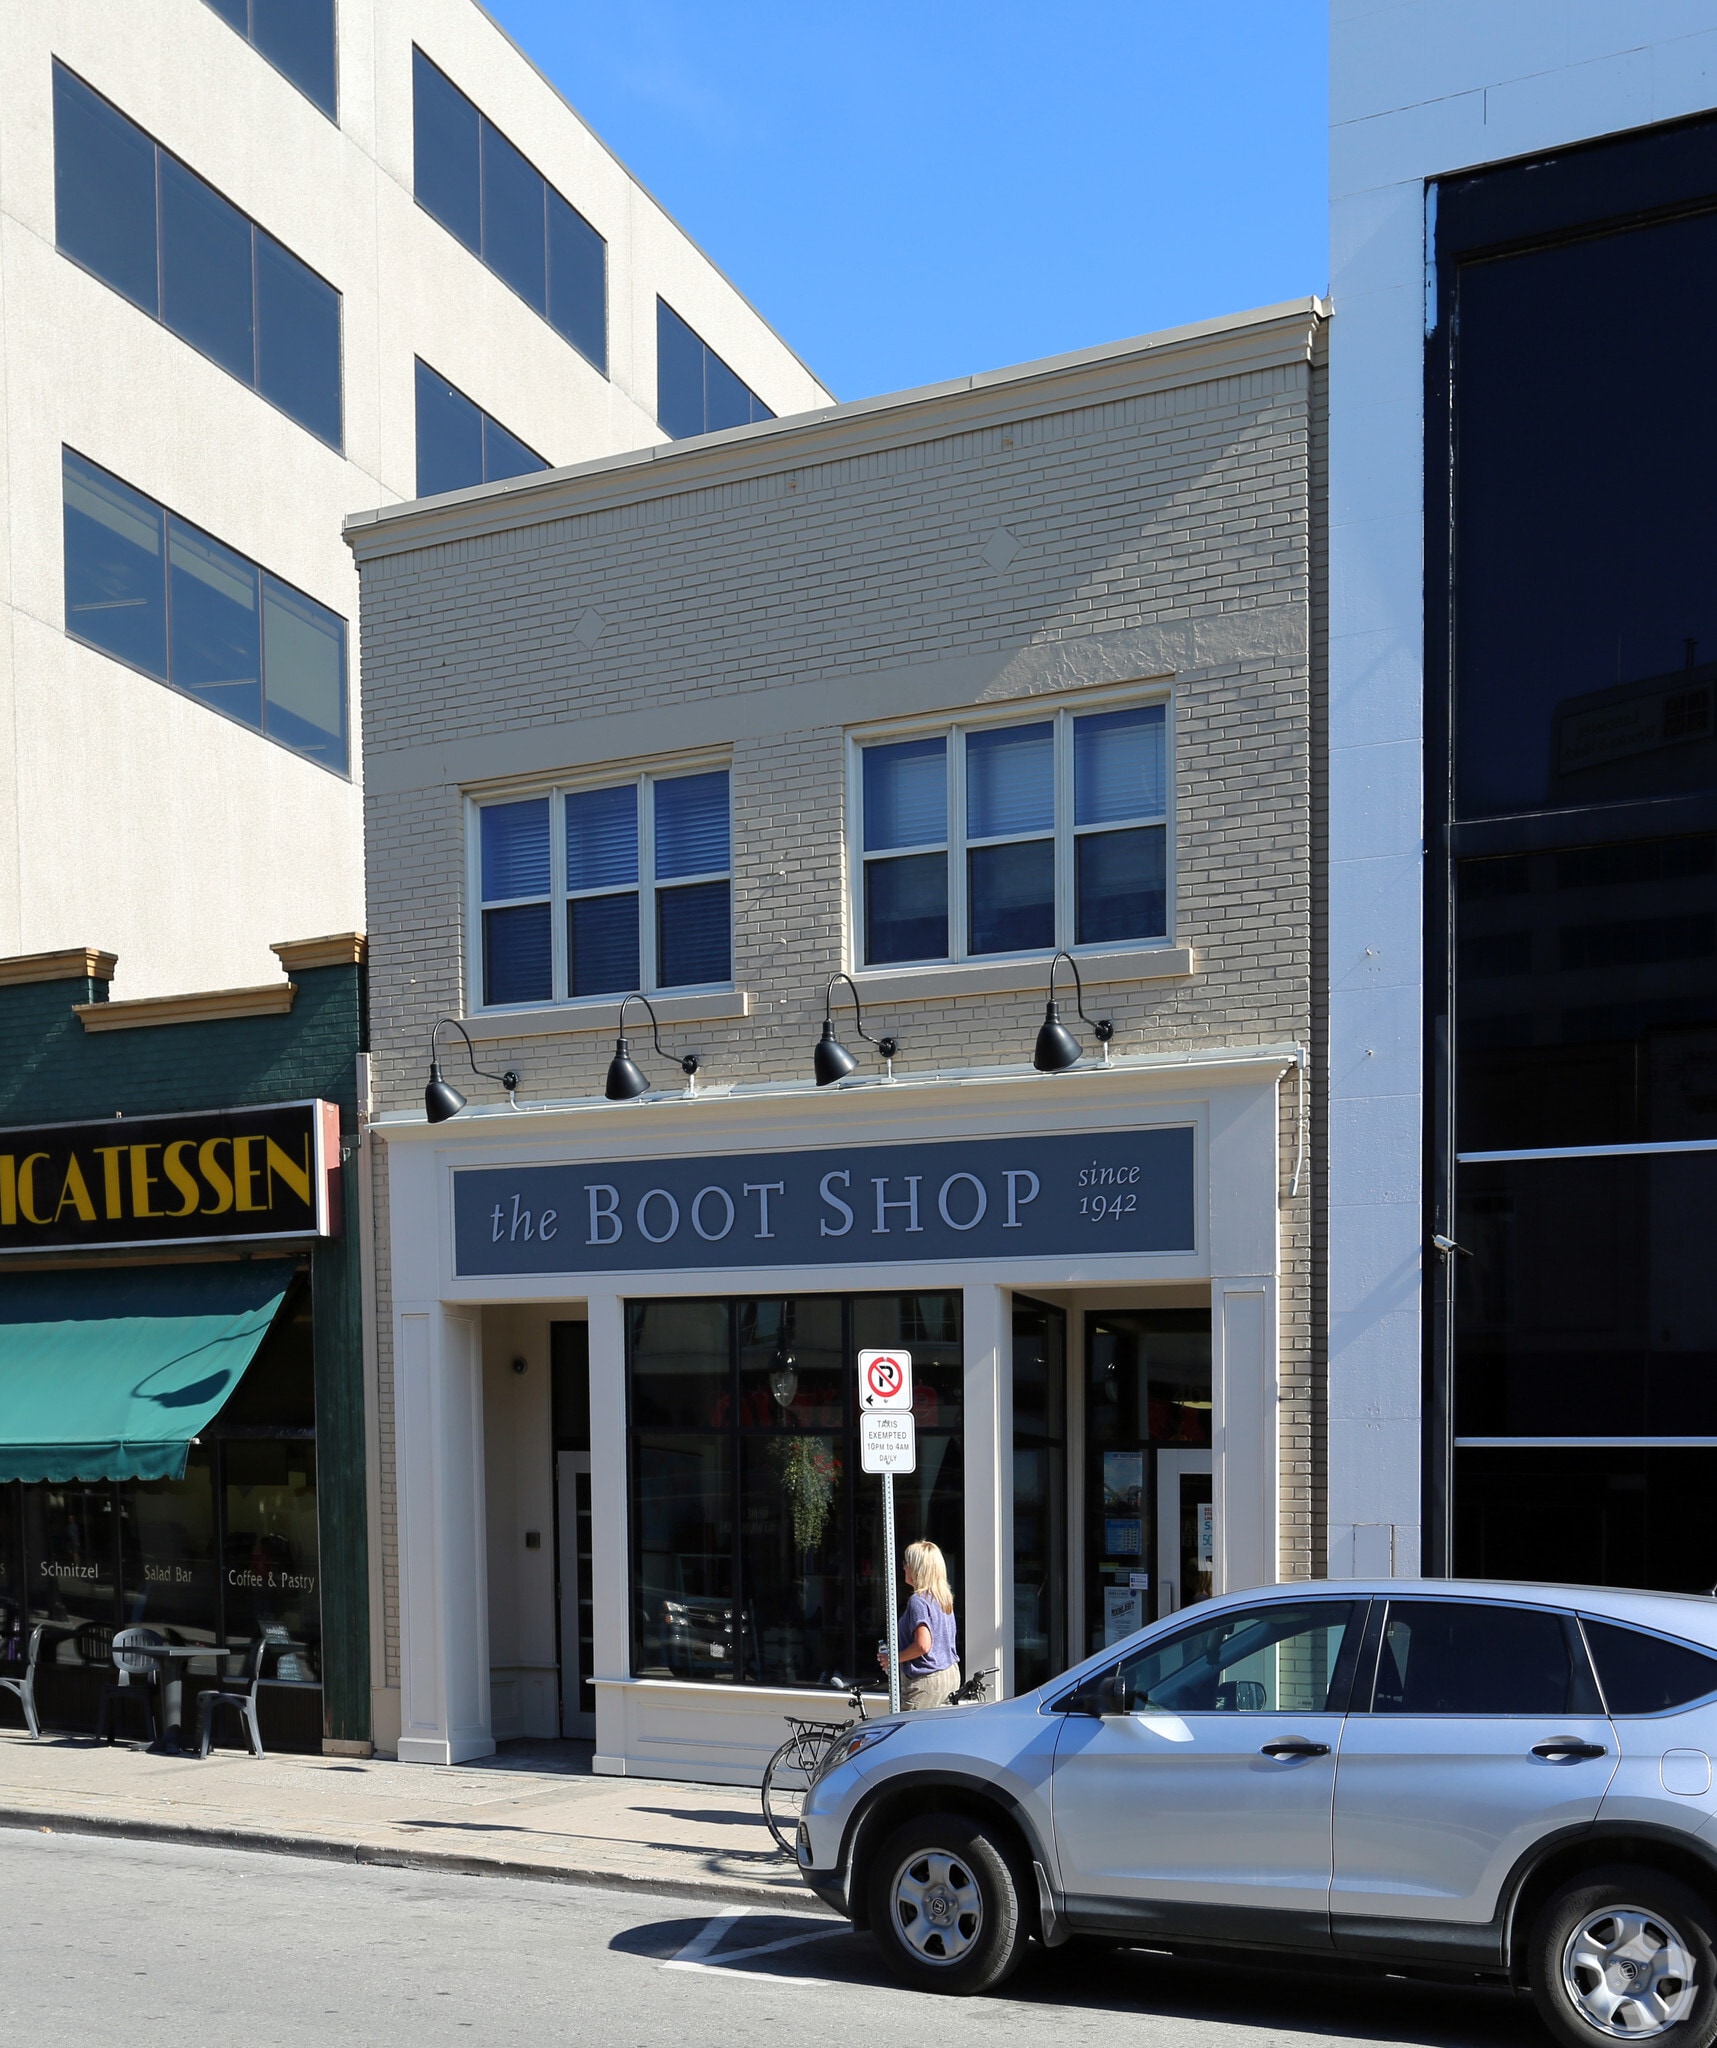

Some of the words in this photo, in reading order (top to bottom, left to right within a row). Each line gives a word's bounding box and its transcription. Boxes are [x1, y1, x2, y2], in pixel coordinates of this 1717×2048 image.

[0, 1132, 311, 1225] ICATESSEN
[1078, 1160, 1141, 1187] since
[490, 1193, 558, 1243] the
[584, 1181, 784, 1245] BOOT
[819, 1170, 1041, 1237] SHOP
[1079, 1194, 1138, 1222] 1942
[877, 1420, 898, 1428] TAXIS
[868, 1431, 907, 1439] EXEMPTED
[867, 1442, 885, 1450] 10PM
[895, 1442, 909, 1450] 4AM
[879, 1454, 898, 1462] DAILY
[40, 1561, 99, 1579] Schnitzel
[144, 1565, 171, 1582] Salad
[176, 1567, 192, 1583] Bar
[228, 1569, 263, 1588] Coffee
[268, 1572, 277, 1588] &
[281, 1572, 315, 1594] Pastry
